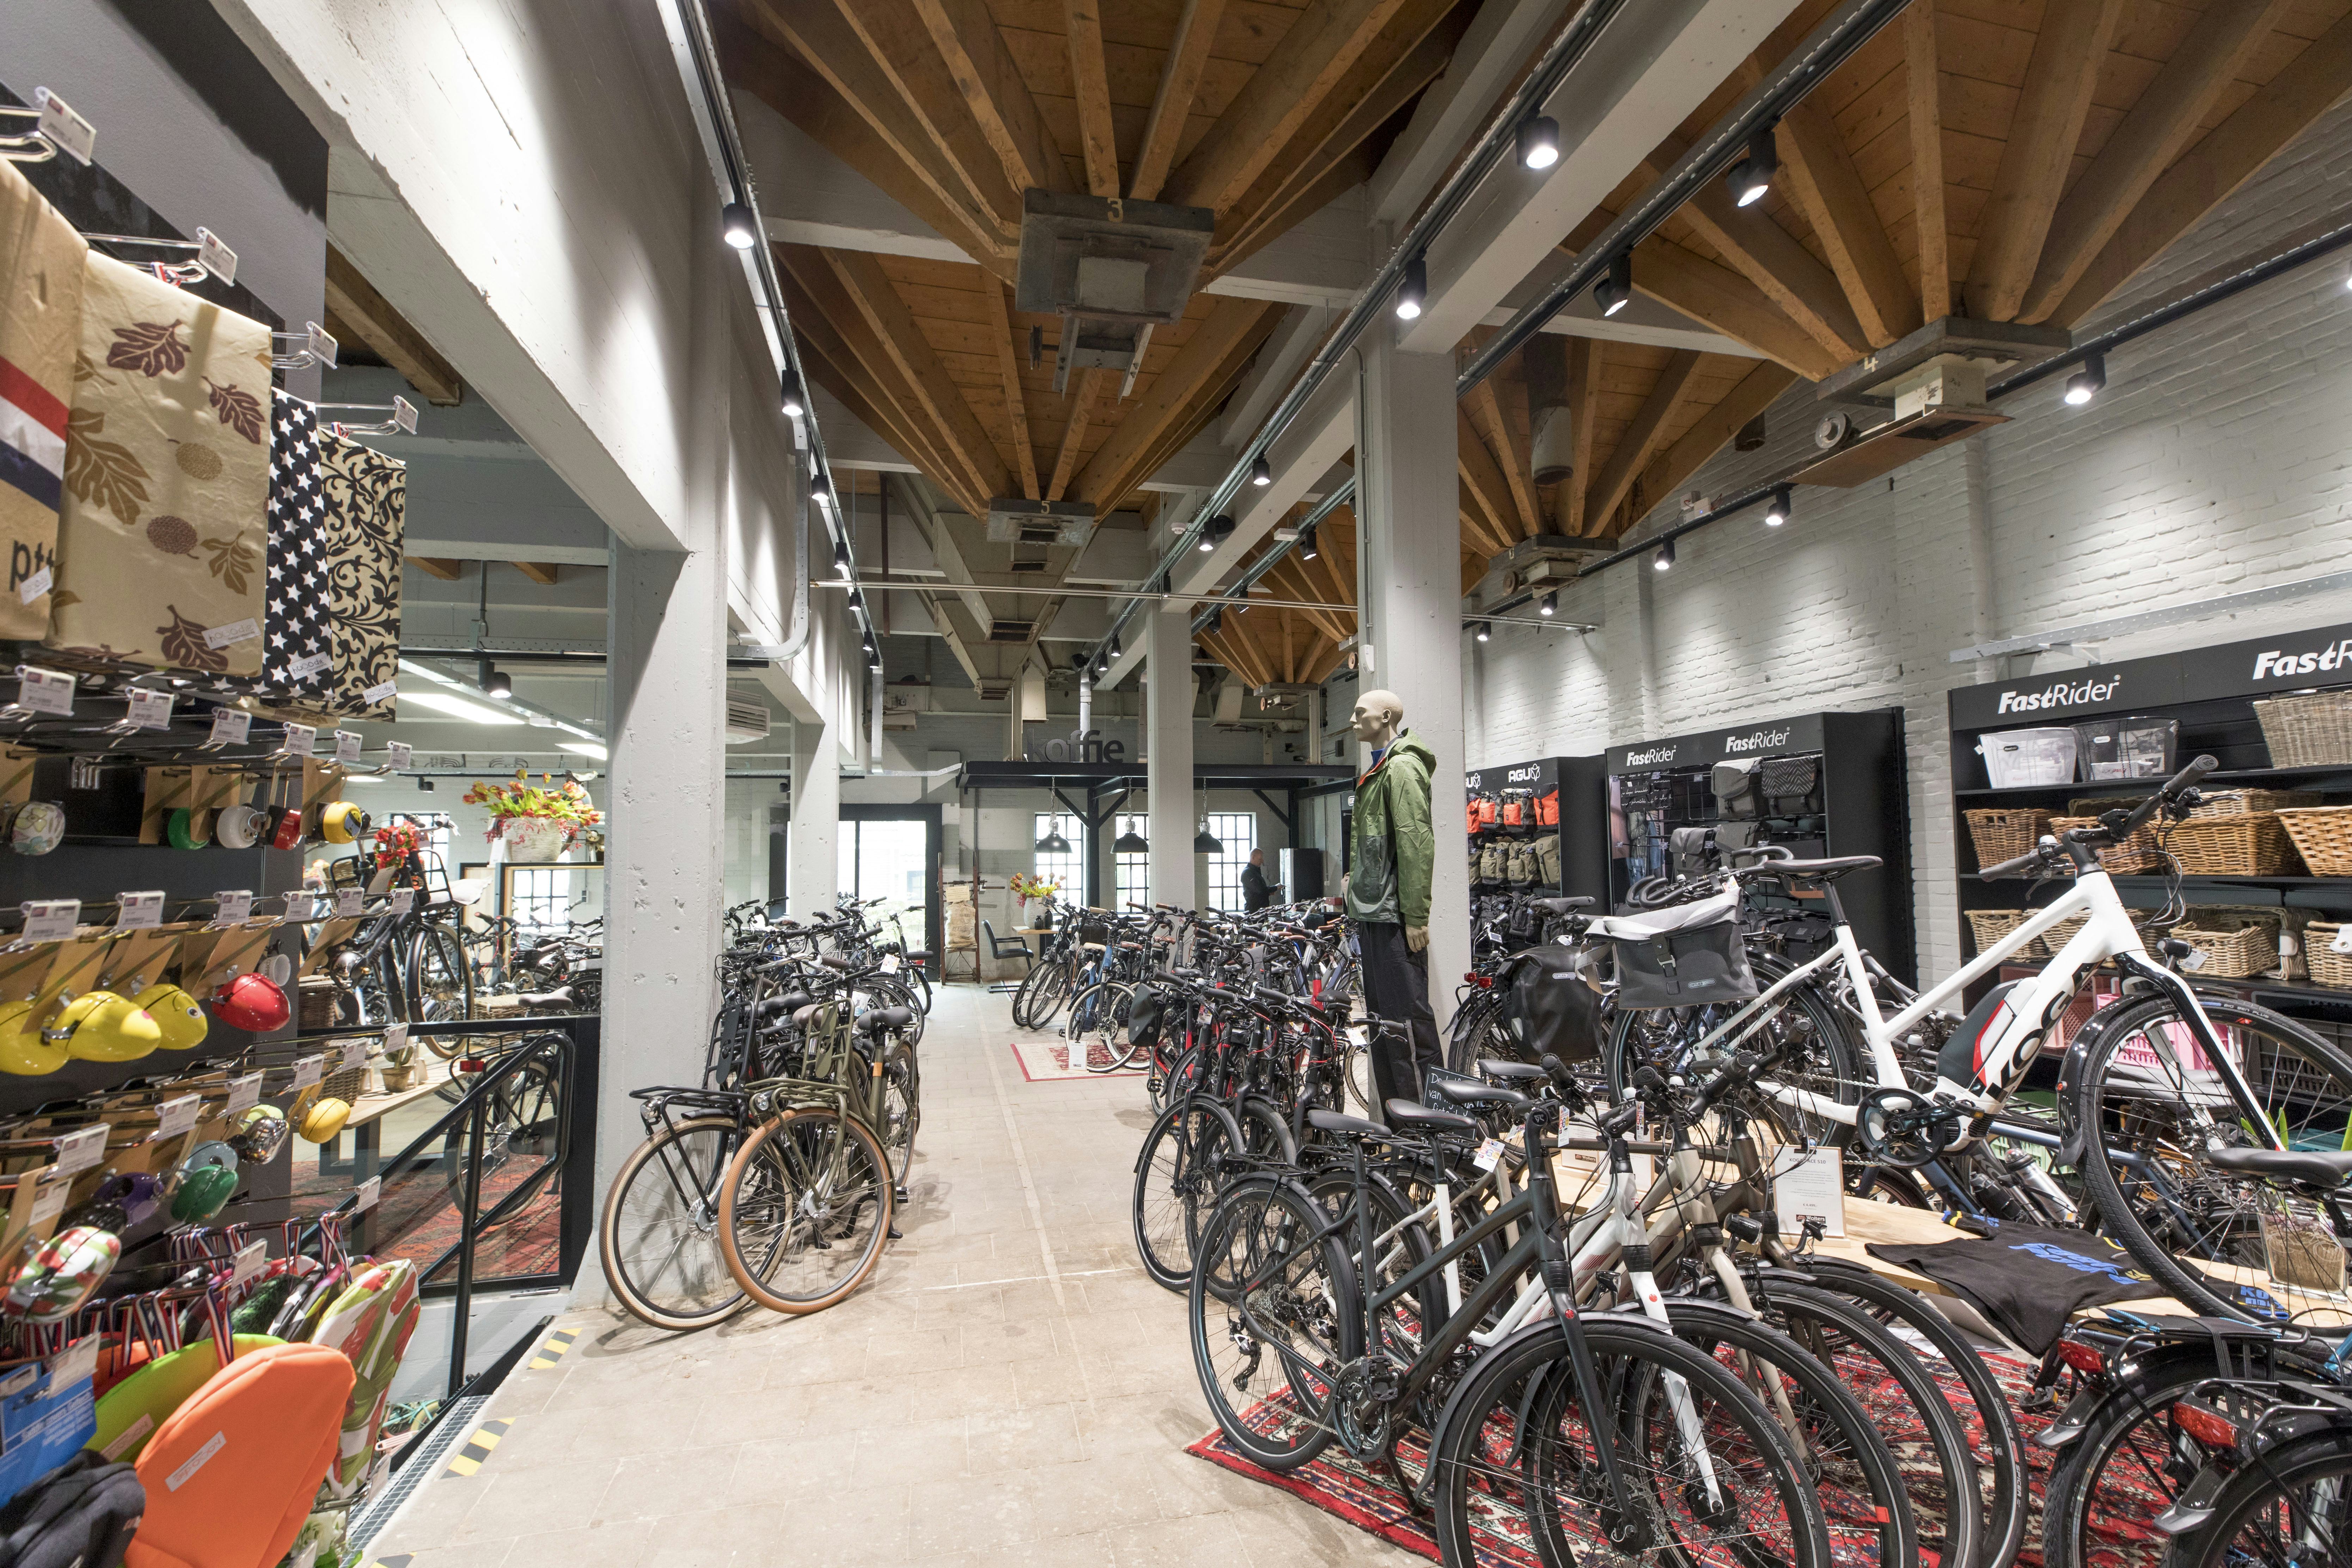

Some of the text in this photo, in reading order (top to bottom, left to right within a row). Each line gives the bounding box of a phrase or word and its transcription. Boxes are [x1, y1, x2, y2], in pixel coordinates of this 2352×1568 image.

[1998, 680, 2120, 714] FastRider
[1027, 728, 1125, 763] koffie
[1726, 730, 1790, 753] FastRider
[1627, 747, 1676, 766] FastRider
[1508, 768, 1531, 783] AGU
[1429, 1089, 1442, 1099] van
[1391, 1252, 1403, 1265] KOGA
[1444, 1381, 1455, 1397] SHIMANO
[1995, 1397, 2014, 1438] SCHWALBE
[1756, 1415, 1787, 1457] SCHWALBE
[1798, 1486, 1815, 1525] SPICER
